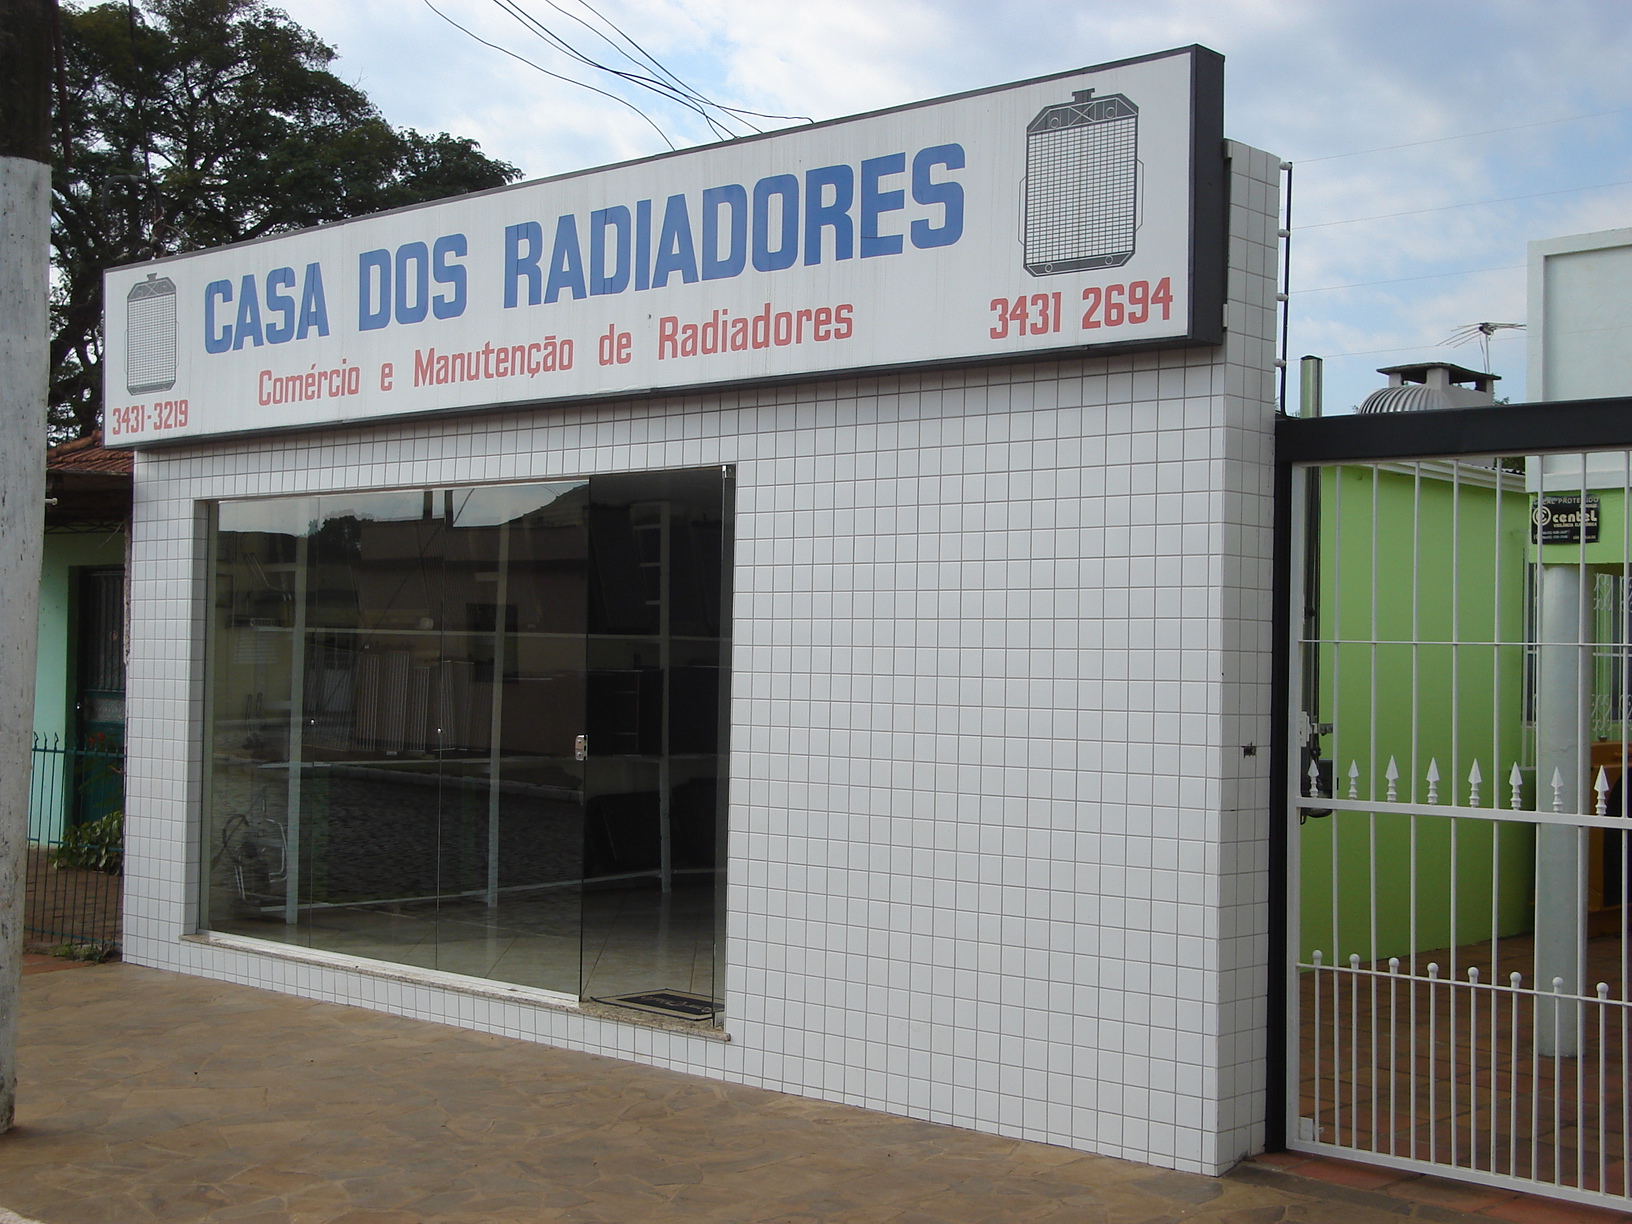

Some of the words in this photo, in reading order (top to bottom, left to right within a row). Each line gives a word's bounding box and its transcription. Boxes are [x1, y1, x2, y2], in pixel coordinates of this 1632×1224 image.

[204, 261, 330, 355] CASA
[359, 233, 468, 332] DOS
[503, 142, 966, 309] RADIADORES
[989, 291, 1062, 340] 3431
[1081, 276, 1174, 330] 2694
[258, 357, 361, 406] Comércio
[380, 362, 393, 392] e
[413, 334, 574, 388] Manutenção
[598, 323, 632, 366] de
[658, 301, 854, 362] Radiadores
[111, 398, 189, 436] 3431-3219
